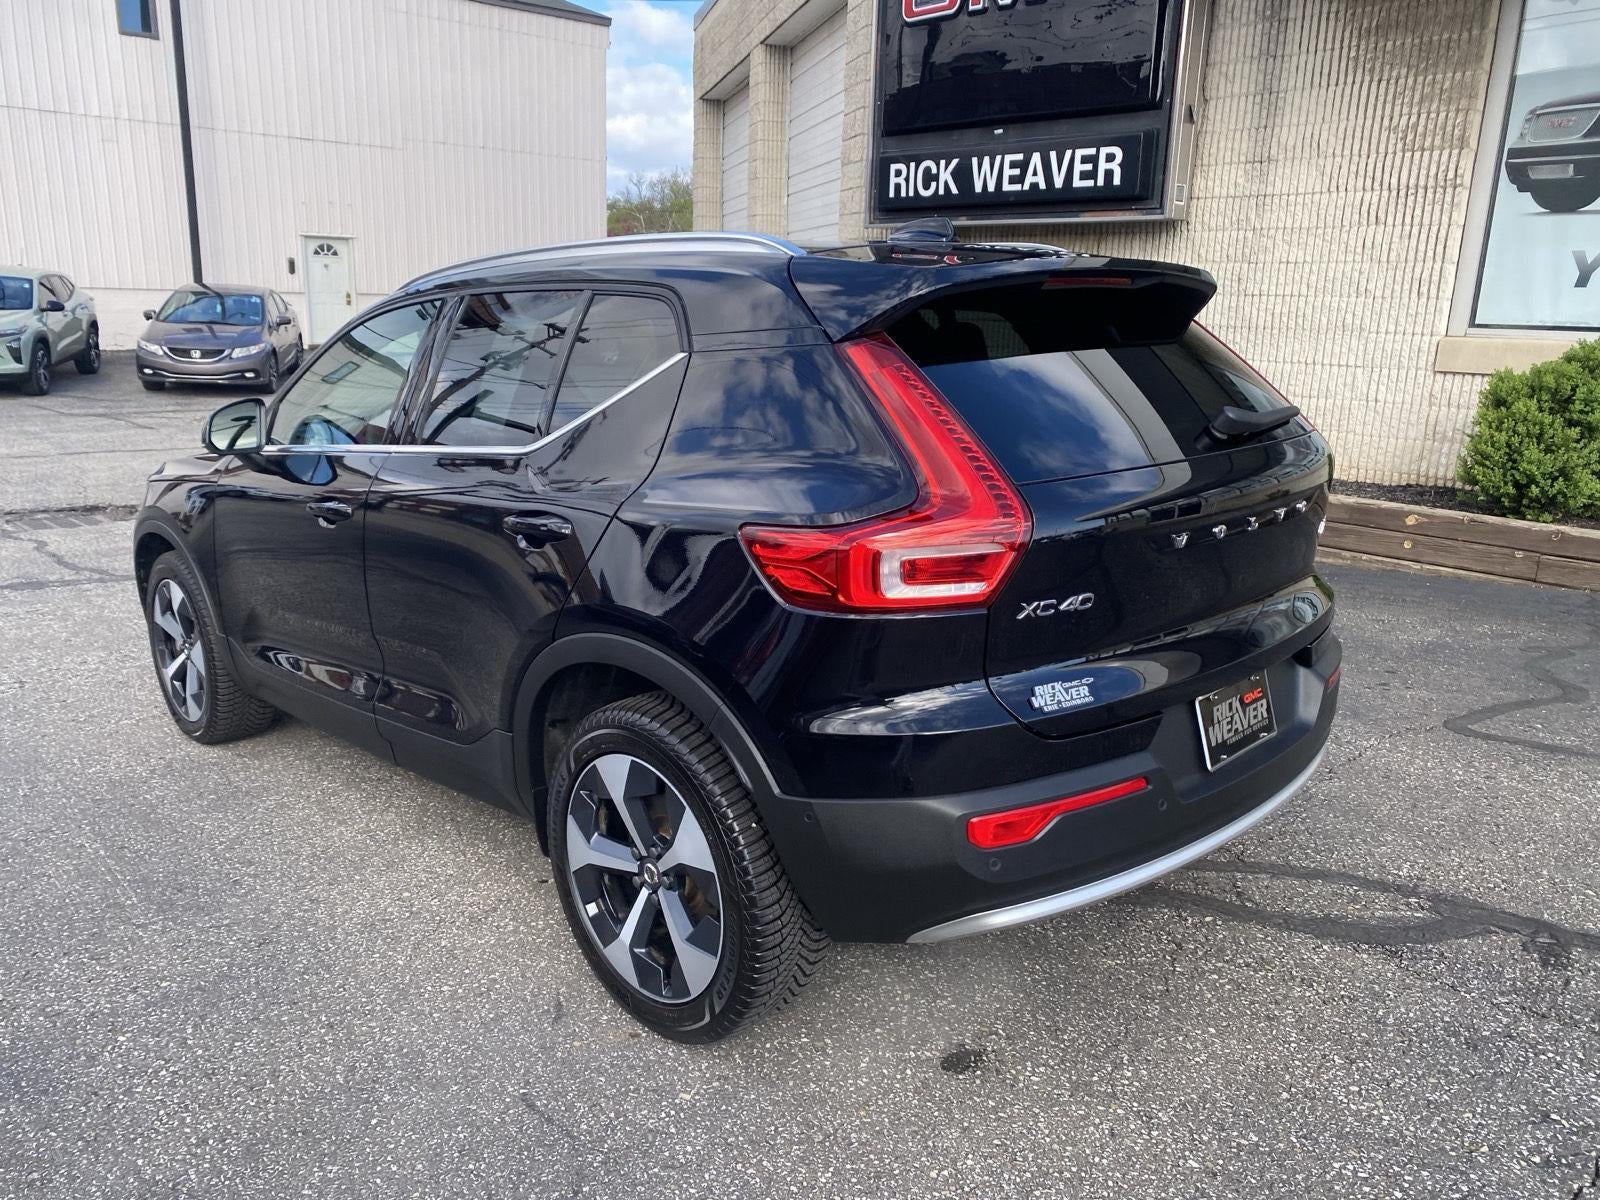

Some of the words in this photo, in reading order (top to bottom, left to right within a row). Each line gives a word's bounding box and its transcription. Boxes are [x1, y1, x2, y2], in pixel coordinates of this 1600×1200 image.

[888, 157, 960, 198] RICK
[971, 145, 1123, 193] WEAVER
[1016, 592, 1095, 619] XC40
[1031, 685, 1090, 708] WEAVER
[1034, 681, 1062, 697] RICK
[1243, 688, 1263, 704] GMC
[1043, 703, 1060, 712] ERIE
[1213, 695, 1240, 724] RICK
[1208, 699, 1268, 747] WEAVER
